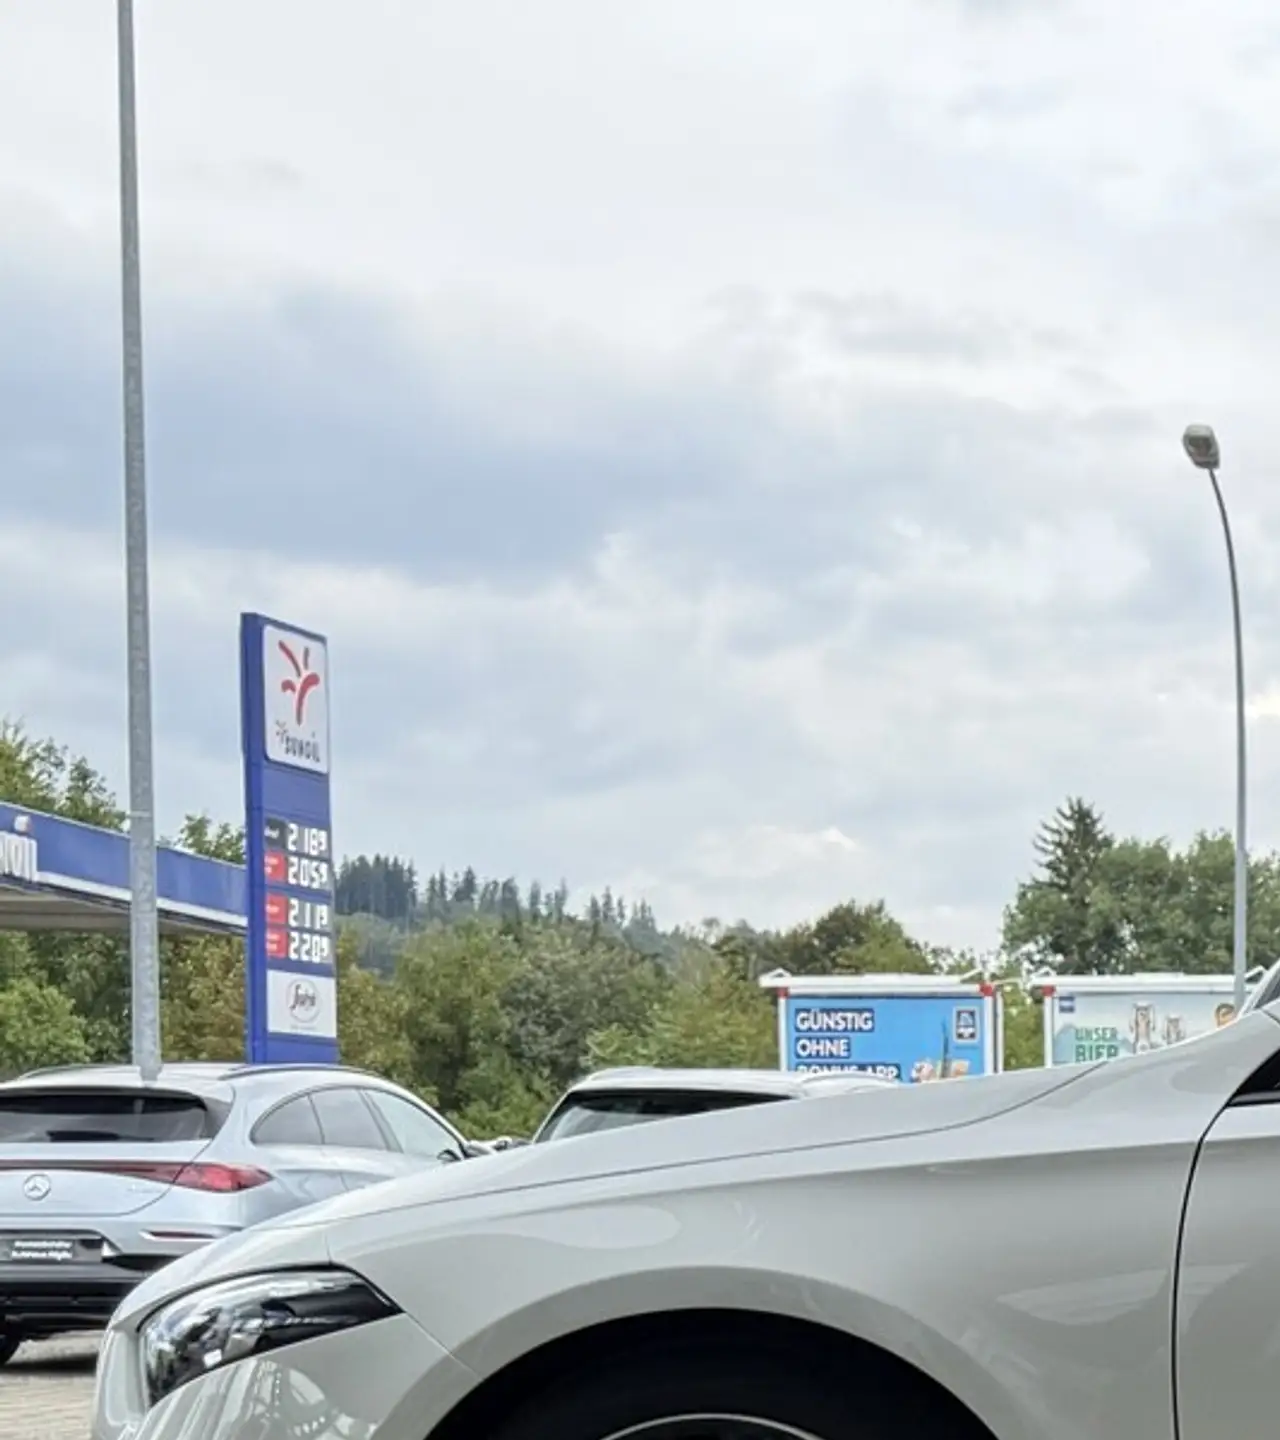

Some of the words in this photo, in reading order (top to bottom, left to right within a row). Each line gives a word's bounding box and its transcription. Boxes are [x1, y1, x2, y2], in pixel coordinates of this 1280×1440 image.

[796, 1010, 874, 1031] GÜNSTIG
[1075, 1027, 1117, 1041] UNSER
[796, 1038, 849, 1057] OHNE
